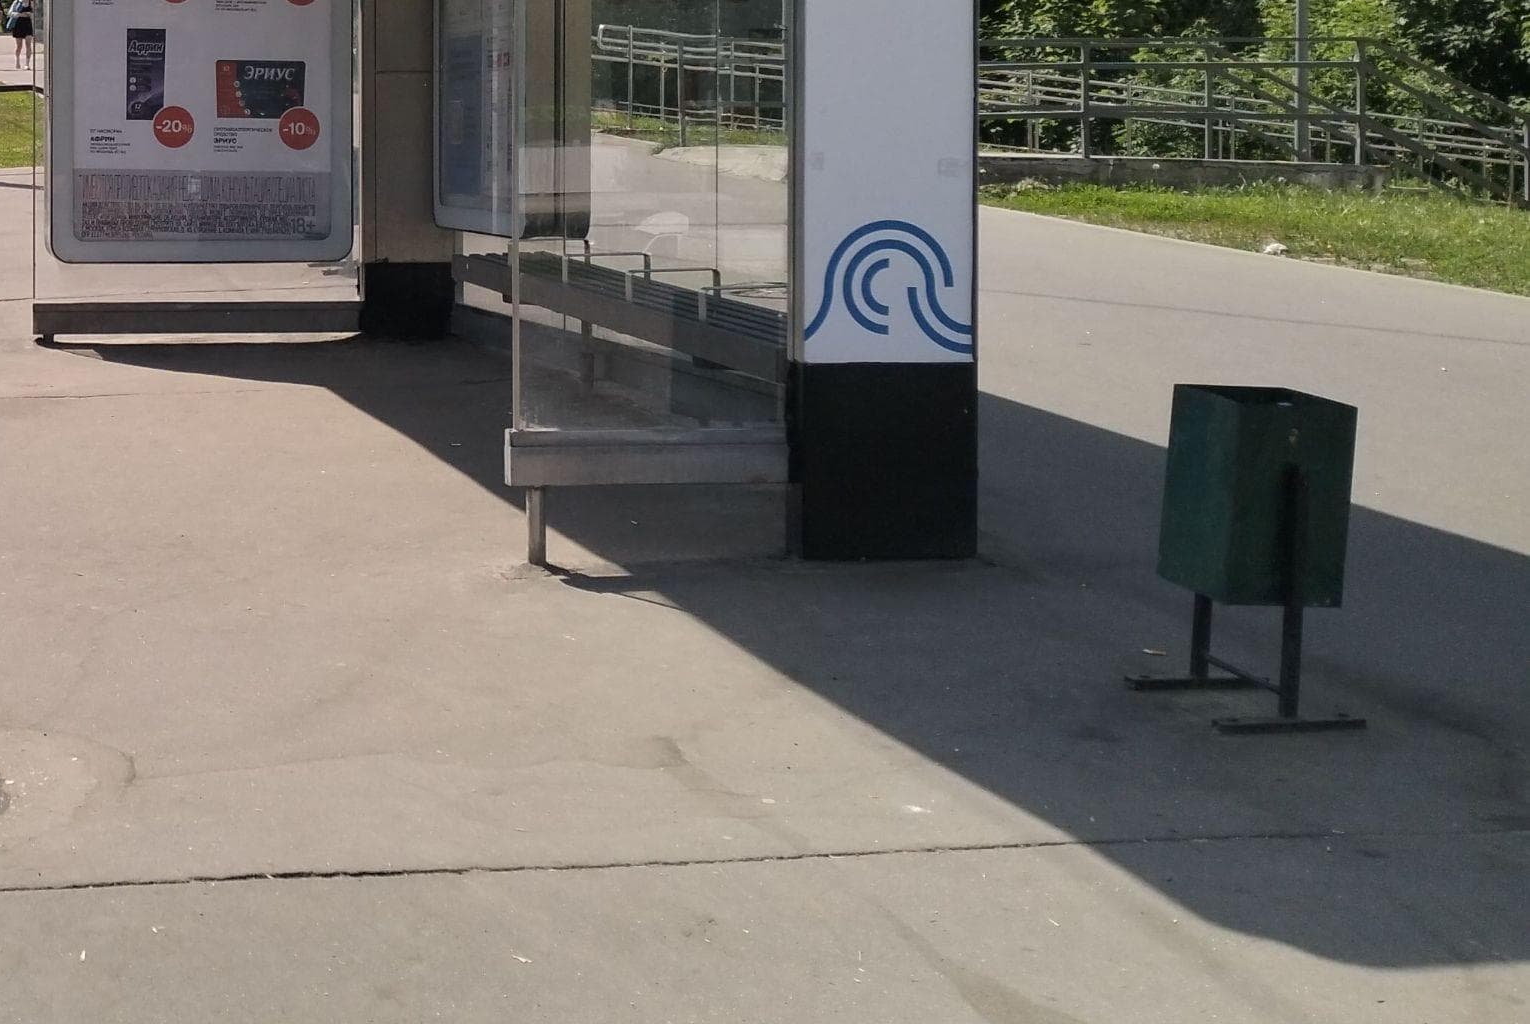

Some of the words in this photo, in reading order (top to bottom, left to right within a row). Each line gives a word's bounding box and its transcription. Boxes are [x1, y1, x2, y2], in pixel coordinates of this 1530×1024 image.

[128, 40, 164, 55] Африн
[244, 65, 295, 81] ЭРИУС
[290, 218, 316, 234] 18+
